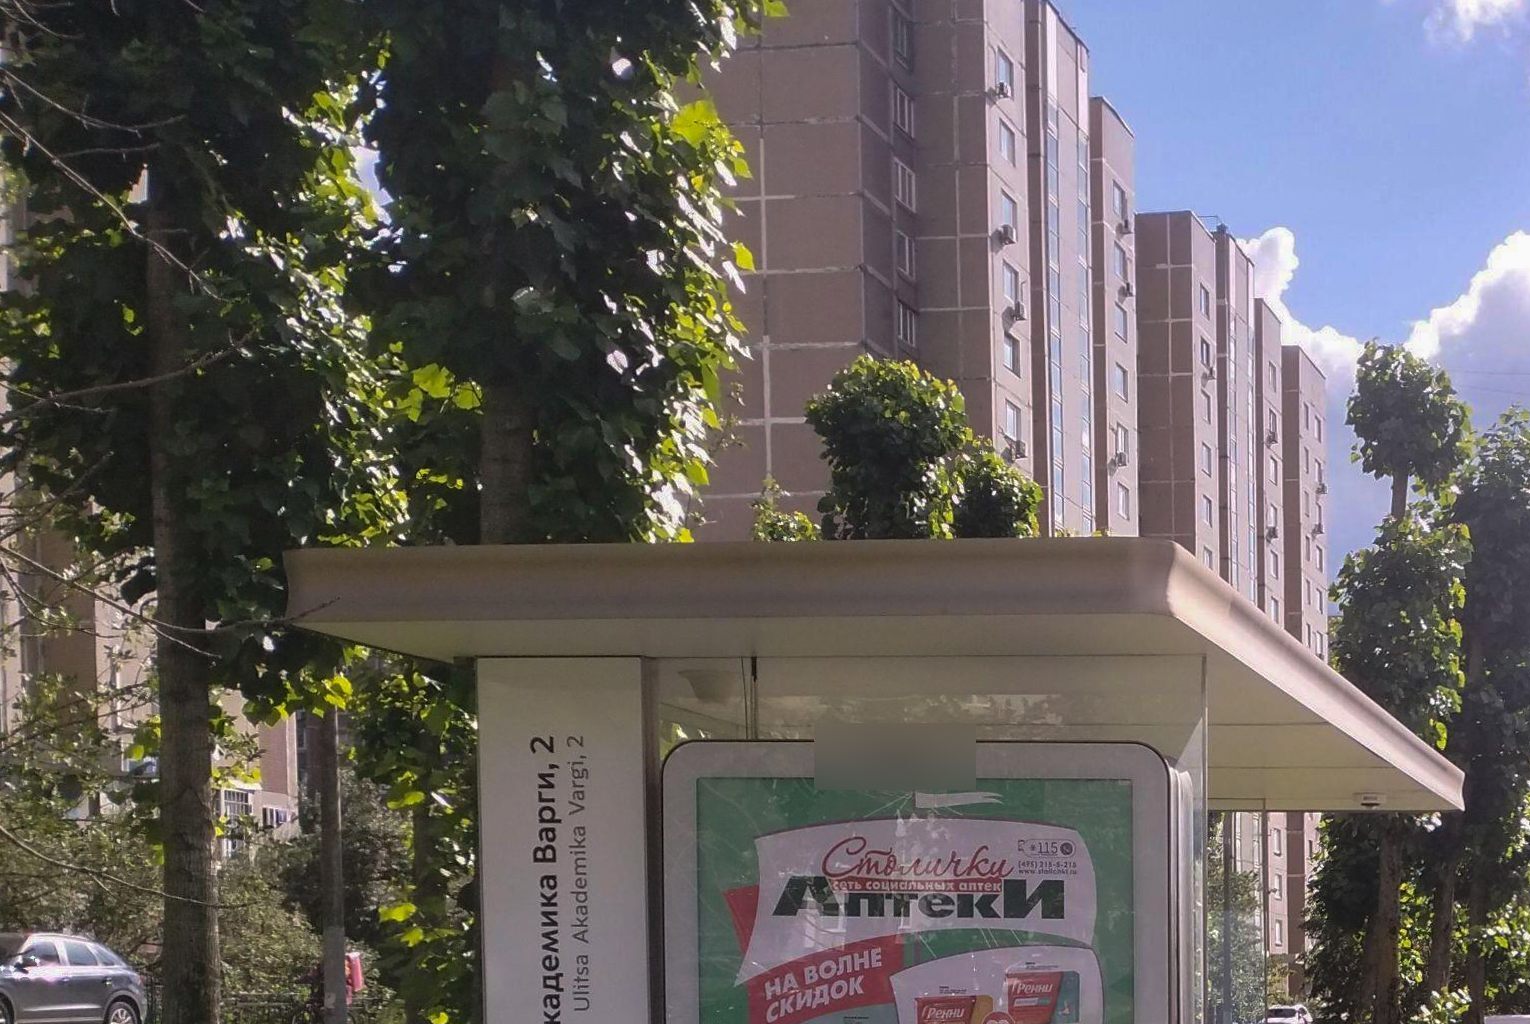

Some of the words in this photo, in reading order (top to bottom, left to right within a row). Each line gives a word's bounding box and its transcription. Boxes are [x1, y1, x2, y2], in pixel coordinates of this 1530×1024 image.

[529, 735, 555, 754] 2
[566, 735, 584, 748] 2
[567, 755, 589, 816] Vargi,
[532, 763, 563, 863] Варги,
[821, 836, 1014, 878] Столички
[568, 825, 589, 944] Akademika
[832, 881, 862, 890] сеть
[865, 882, 955, 891] социальных
[958, 882, 1002, 891] аптек
[571, 954, 590, 1012] Ulitsa
[764, 972, 799, 1001] НА
[803, 947, 882, 986] ВОЛНЕ
[766, 975, 864, 1024] СКИДОК
